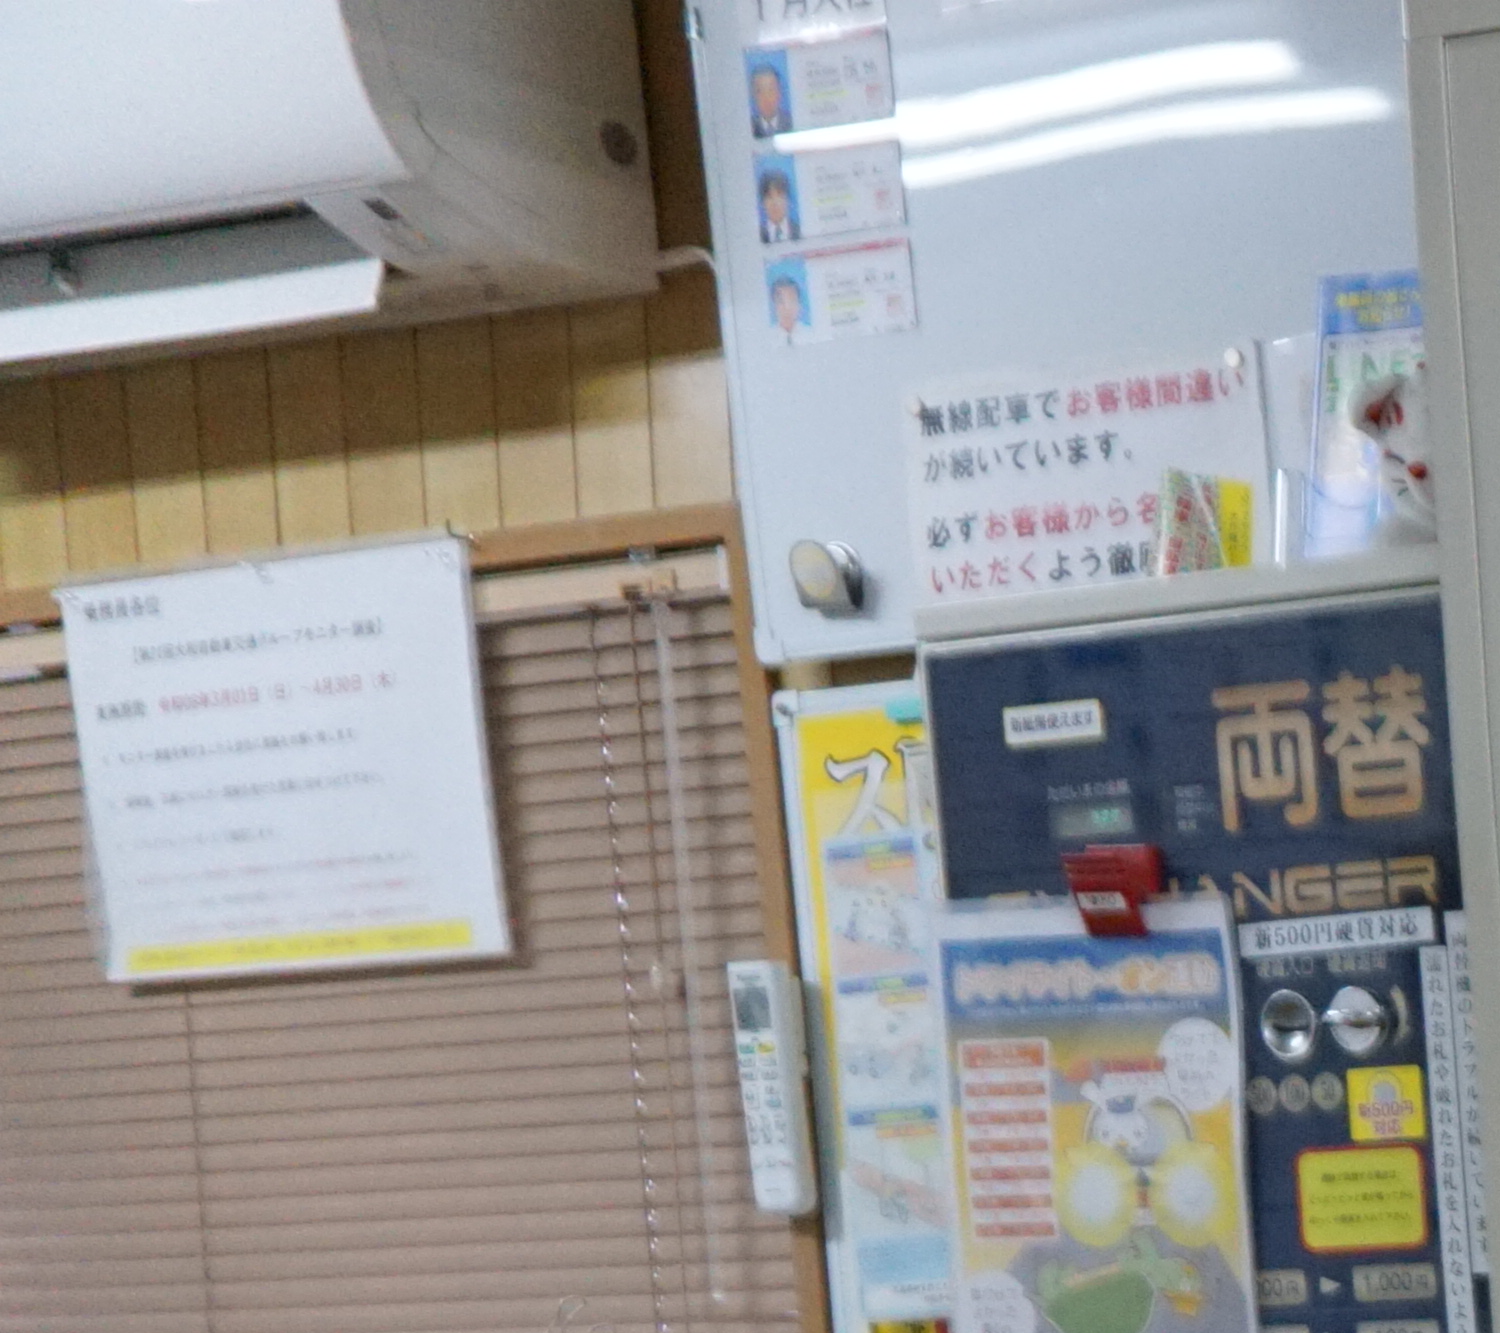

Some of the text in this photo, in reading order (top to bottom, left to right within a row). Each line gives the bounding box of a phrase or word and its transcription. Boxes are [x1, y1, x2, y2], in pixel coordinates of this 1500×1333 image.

[1210, 663, 1432, 835] 両替
[1254, 912, 1420, 951] 新500円硬貨対応
